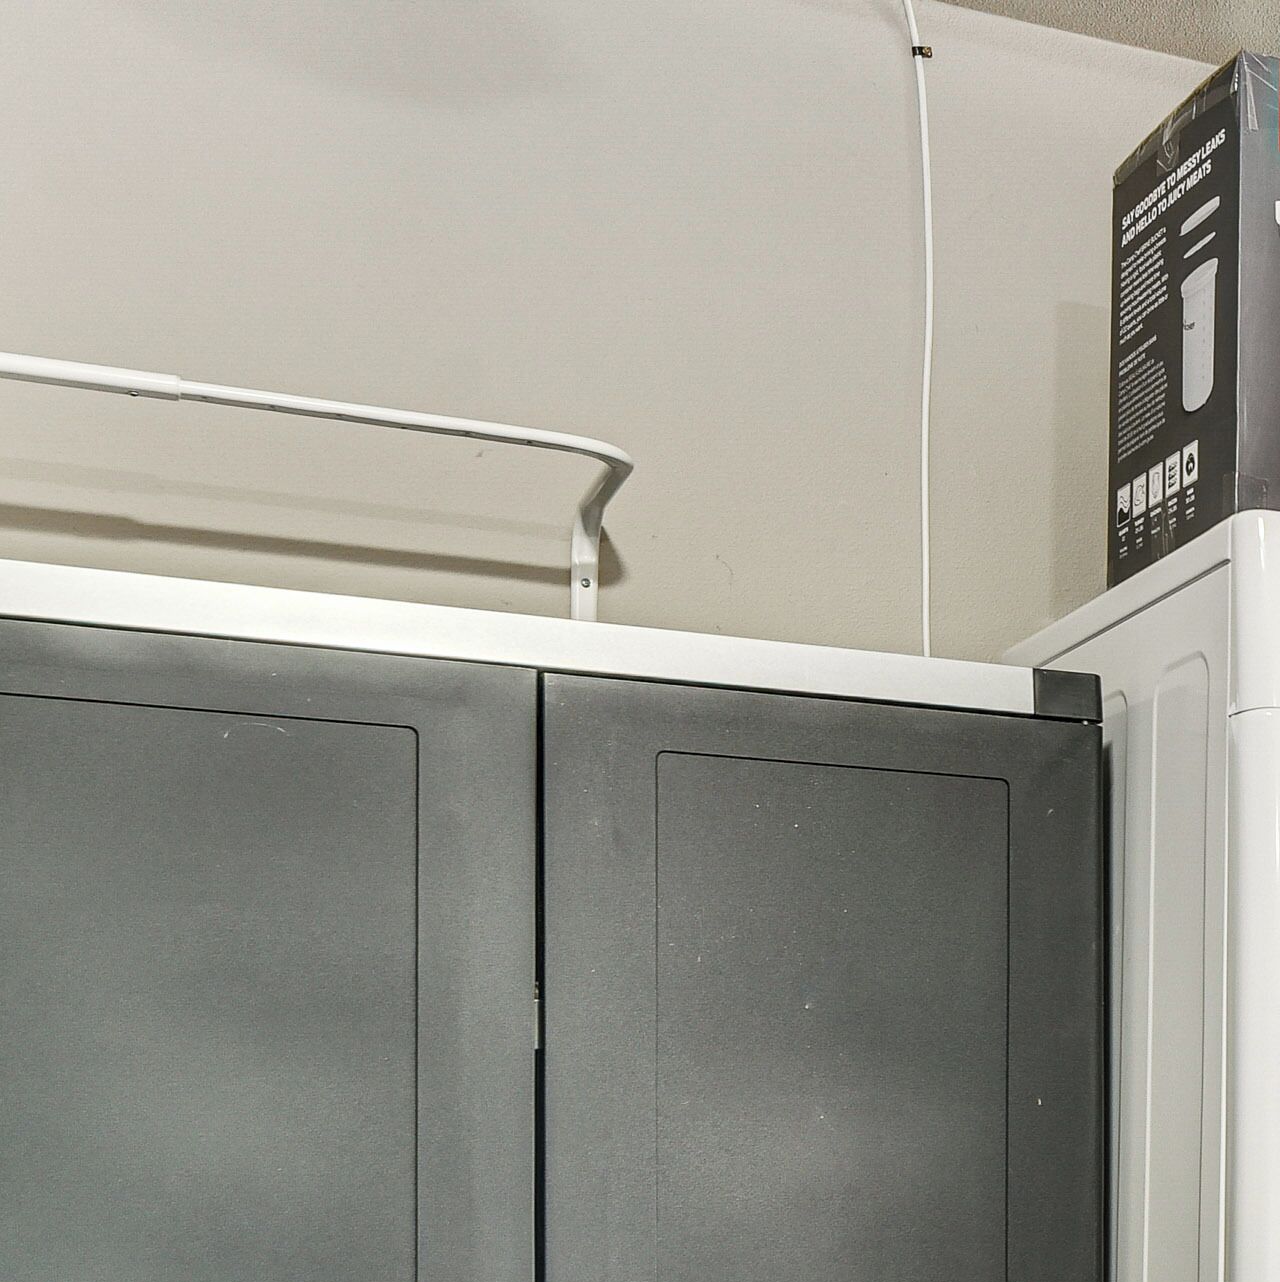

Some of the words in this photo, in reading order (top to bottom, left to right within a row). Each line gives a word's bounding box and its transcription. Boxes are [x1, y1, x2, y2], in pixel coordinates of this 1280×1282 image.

[1121, 226, 1135, 248] AND
[1136, 207, 1157, 235] HELLO
[1158, 198, 1167, 215] TO
[1167, 181, 1186, 208] JUICY
[1186, 159, 1212, 191] MEATS
[1122, 209, 1135, 230] SAY
[1135, 181, 1166, 218] GOODBYE
[1167, 172, 1176, 189] TO
[1176, 149, 1201, 181] MESSY
[1201, 128, 1226, 160] LEAKS
